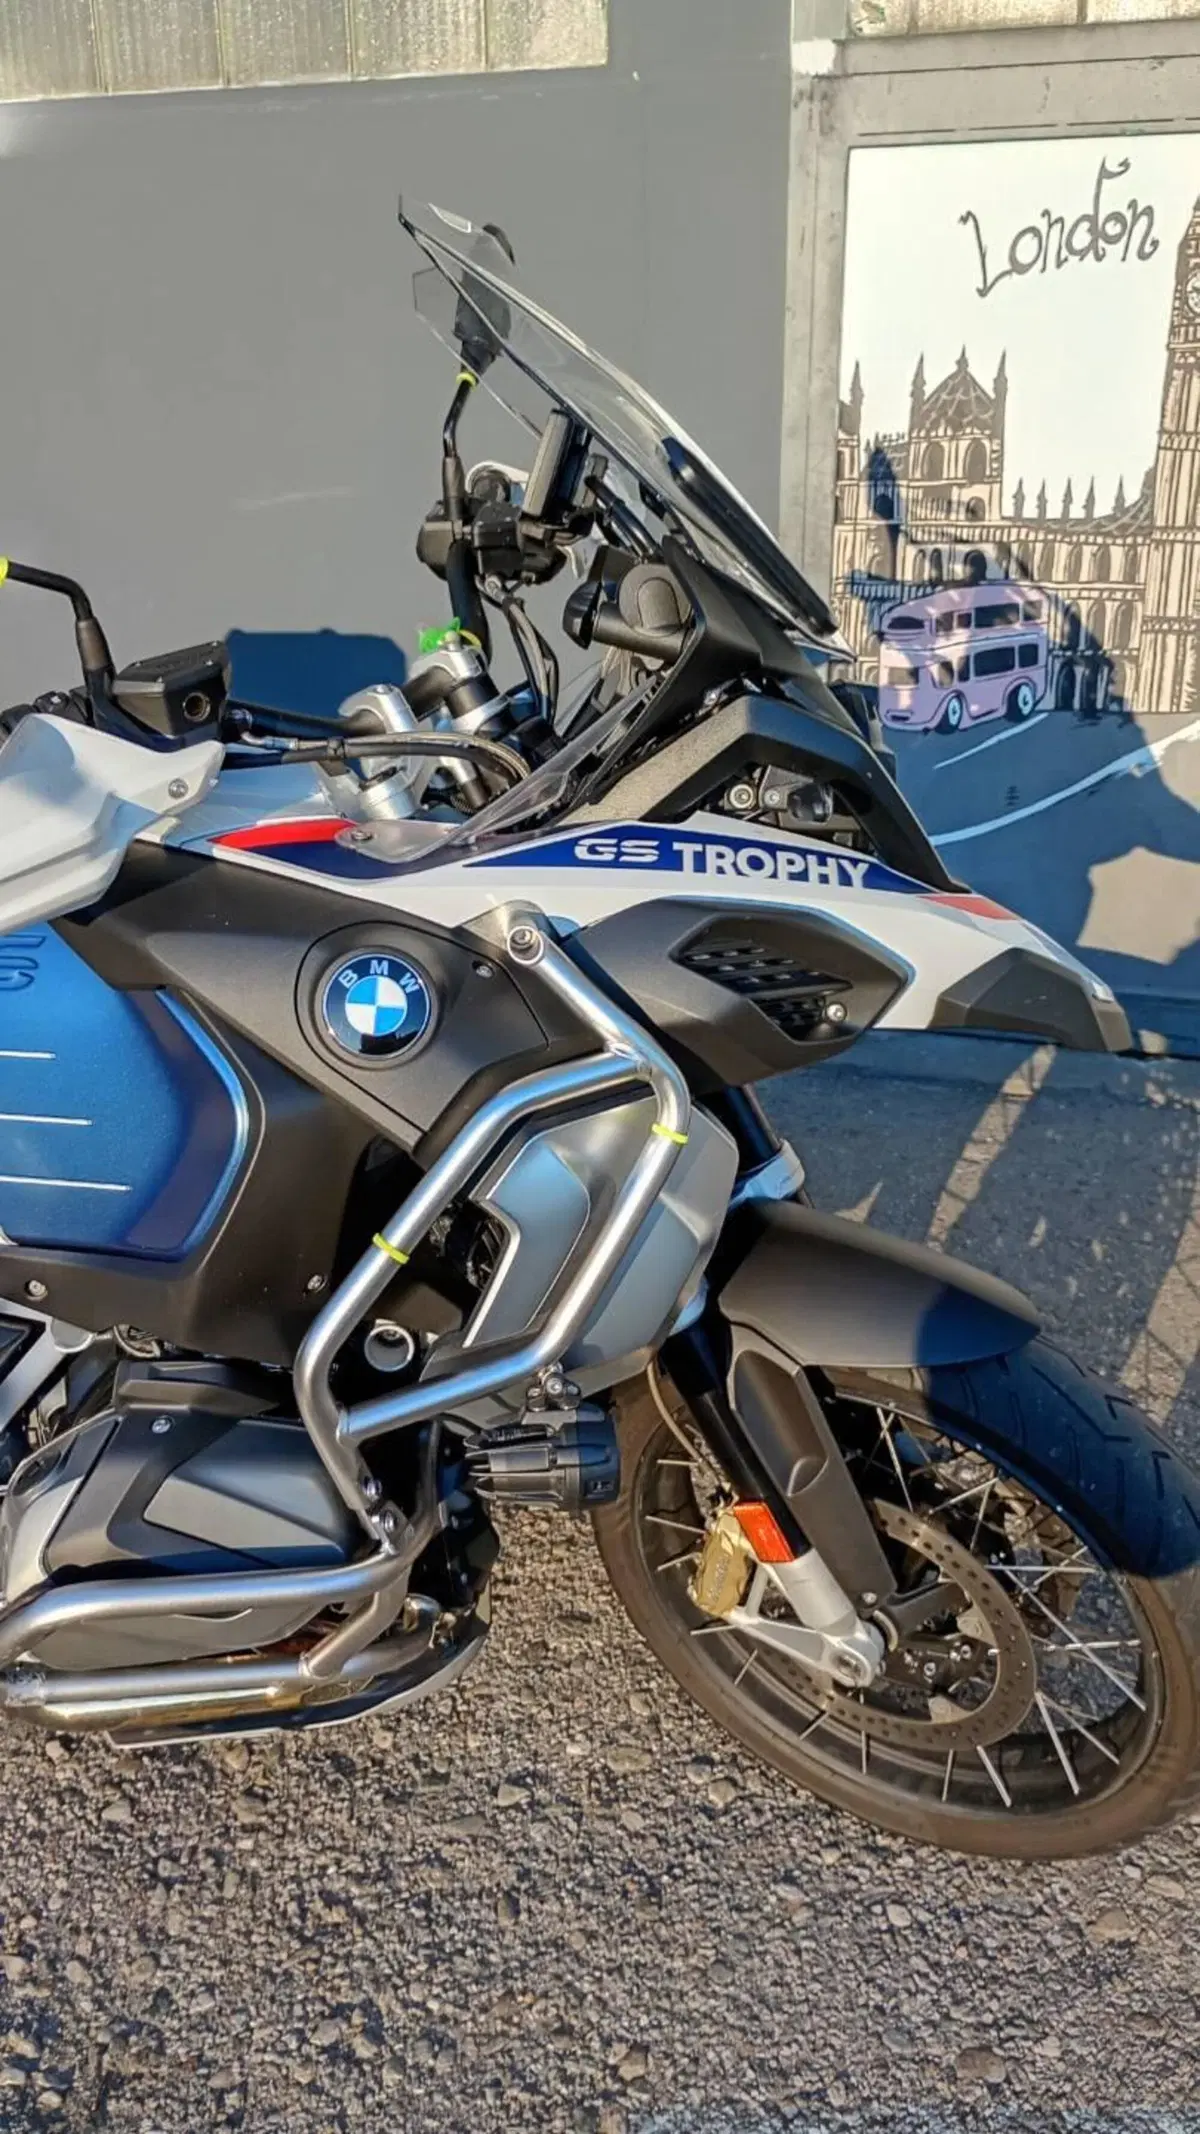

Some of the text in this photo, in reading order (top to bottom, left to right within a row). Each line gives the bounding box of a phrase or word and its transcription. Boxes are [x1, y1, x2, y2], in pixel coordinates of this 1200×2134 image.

[959, 155, 1159, 298] London
[574, 838, 870, 888] GS TROPHY
[338, 959, 420, 994] BMW
